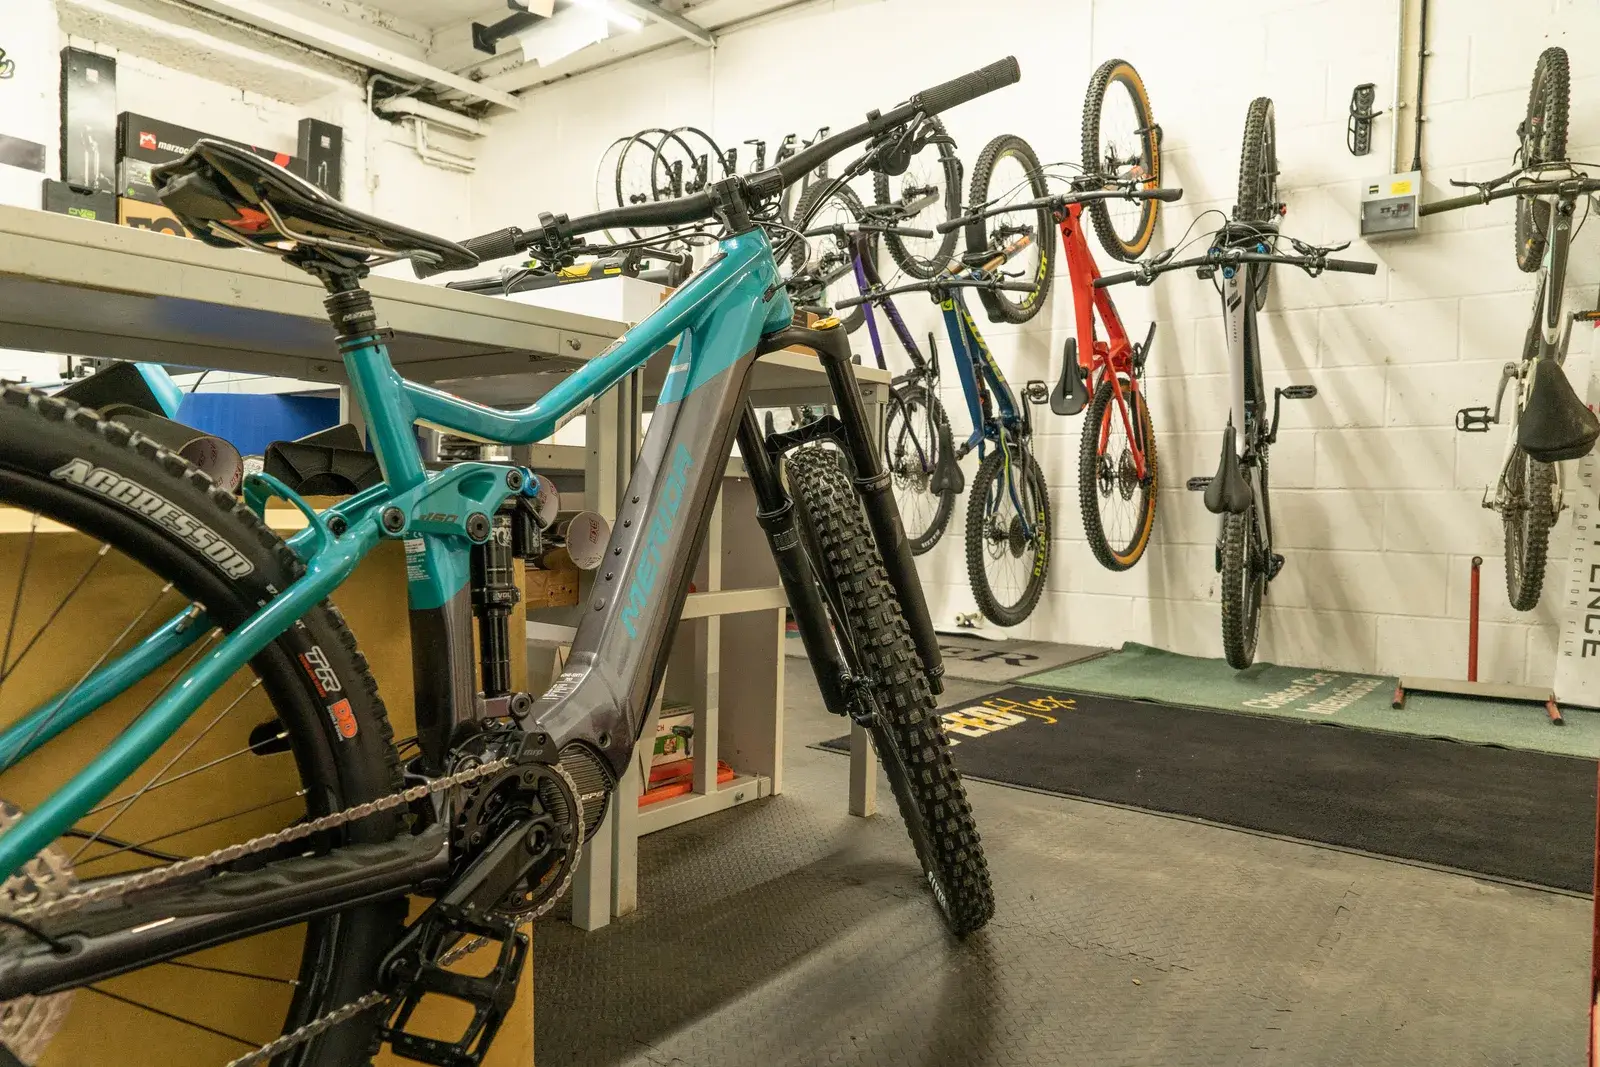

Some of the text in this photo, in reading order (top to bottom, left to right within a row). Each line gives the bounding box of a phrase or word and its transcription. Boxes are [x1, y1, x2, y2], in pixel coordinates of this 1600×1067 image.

[158, 141, 192, 155] marzoc
[51, 458, 254, 580] AGGRESSOR
[620, 442, 694, 640] MERIDA
[1563, 452, 1594, 657] AINT PROTECTION FILM
